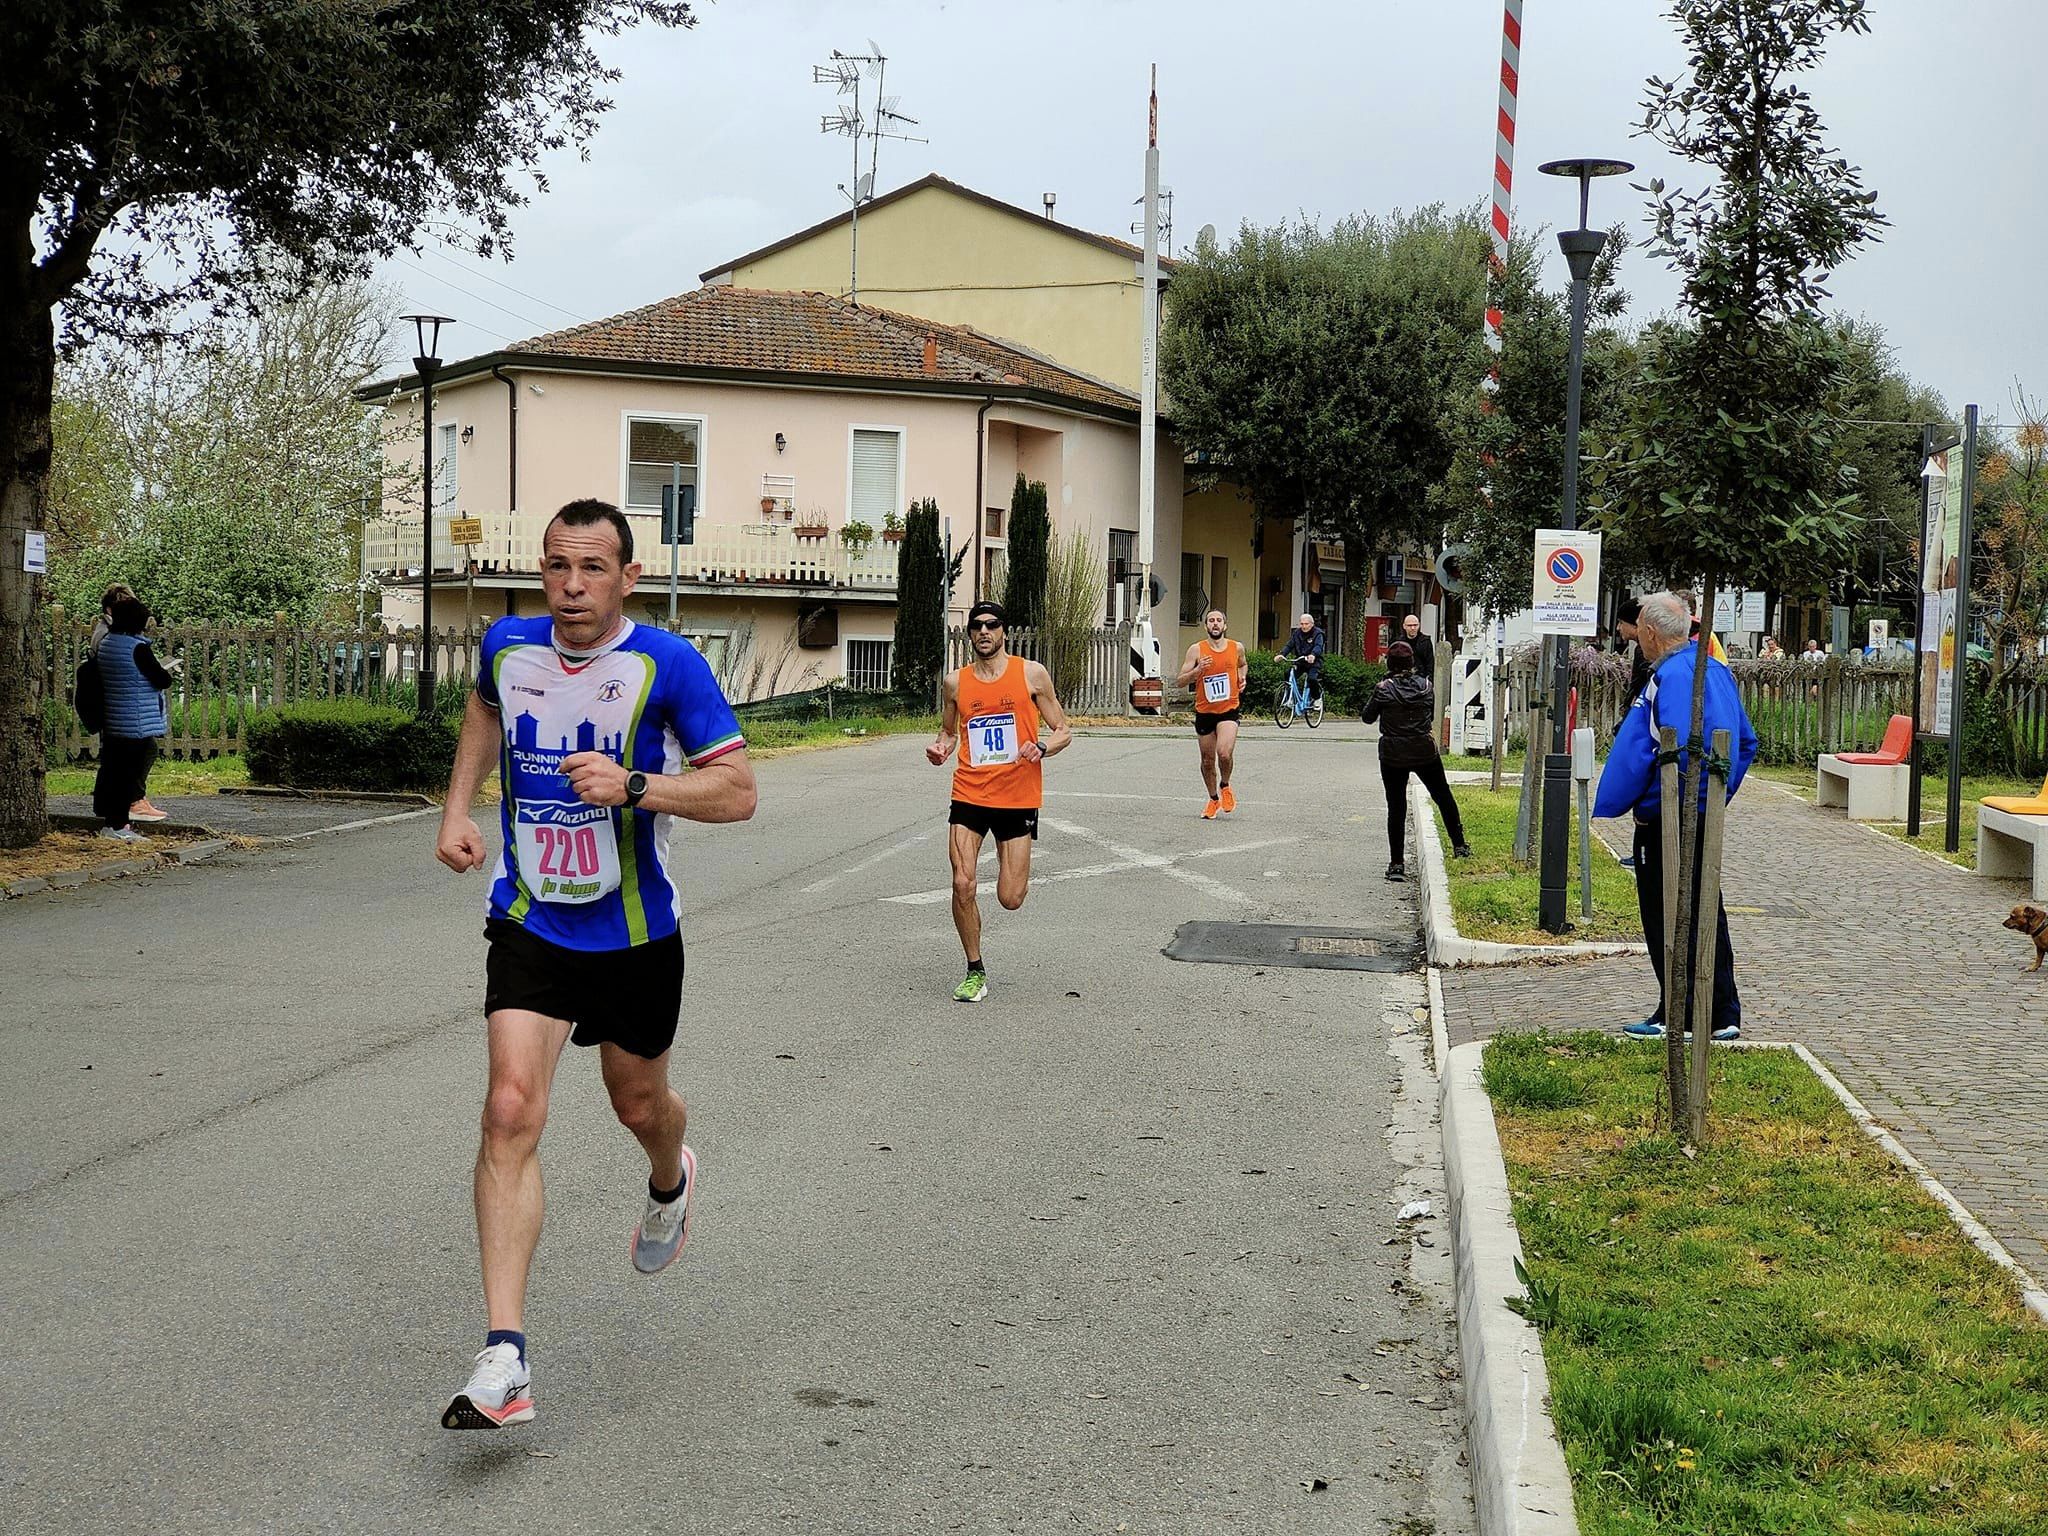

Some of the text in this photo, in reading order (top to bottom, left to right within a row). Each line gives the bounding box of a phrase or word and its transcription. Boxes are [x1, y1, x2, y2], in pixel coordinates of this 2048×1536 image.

[1212, 681, 1224, 694] 117
[984, 728, 1004, 752] 48
[513, 750, 564, 764] RUNNIN
[520, 764, 566, 776] COMA
[550, 808, 606, 824] MIZUNO
[535, 827, 599, 877] 220
